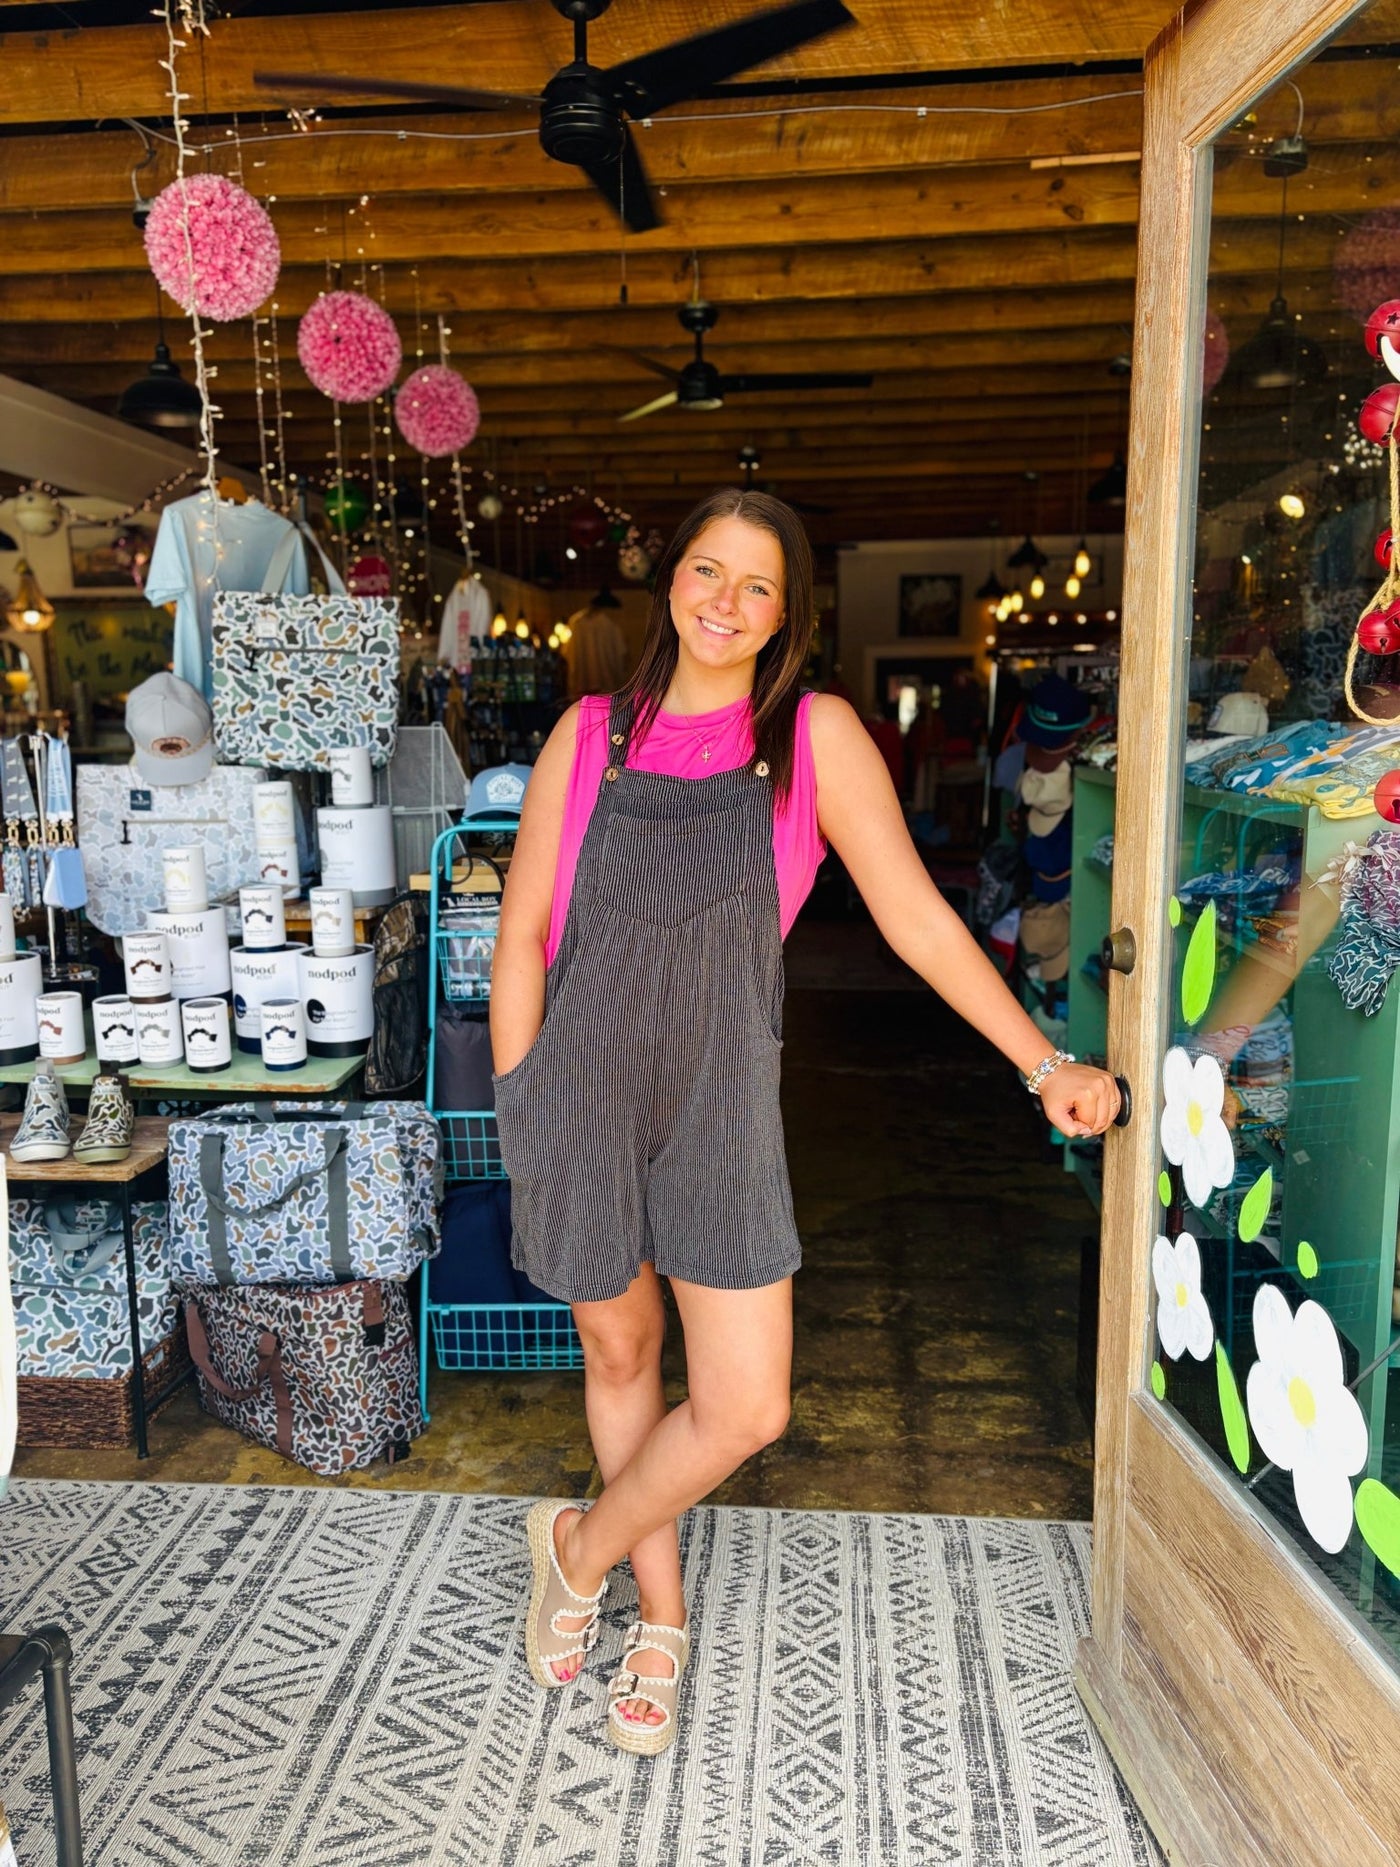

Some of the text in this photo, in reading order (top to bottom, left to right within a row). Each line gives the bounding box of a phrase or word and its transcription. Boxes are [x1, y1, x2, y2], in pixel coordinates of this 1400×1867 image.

[331, 754, 350, 762] odpod
[318, 820, 353, 832] odpod
[311, 897, 340, 906] nodpod
[128, 944, 161, 954] nodpod
[233, 963, 276, 977] nodpod
[307, 966, 357, 981] nodpod
[37, 1007, 61, 1015] odpod
[99, 1008, 132, 1018] nodpod
[137, 1009, 168, 1019] nodpod
[263, 1010, 295, 1021] nodpod
[185, 1013, 216, 1023] nodpod
